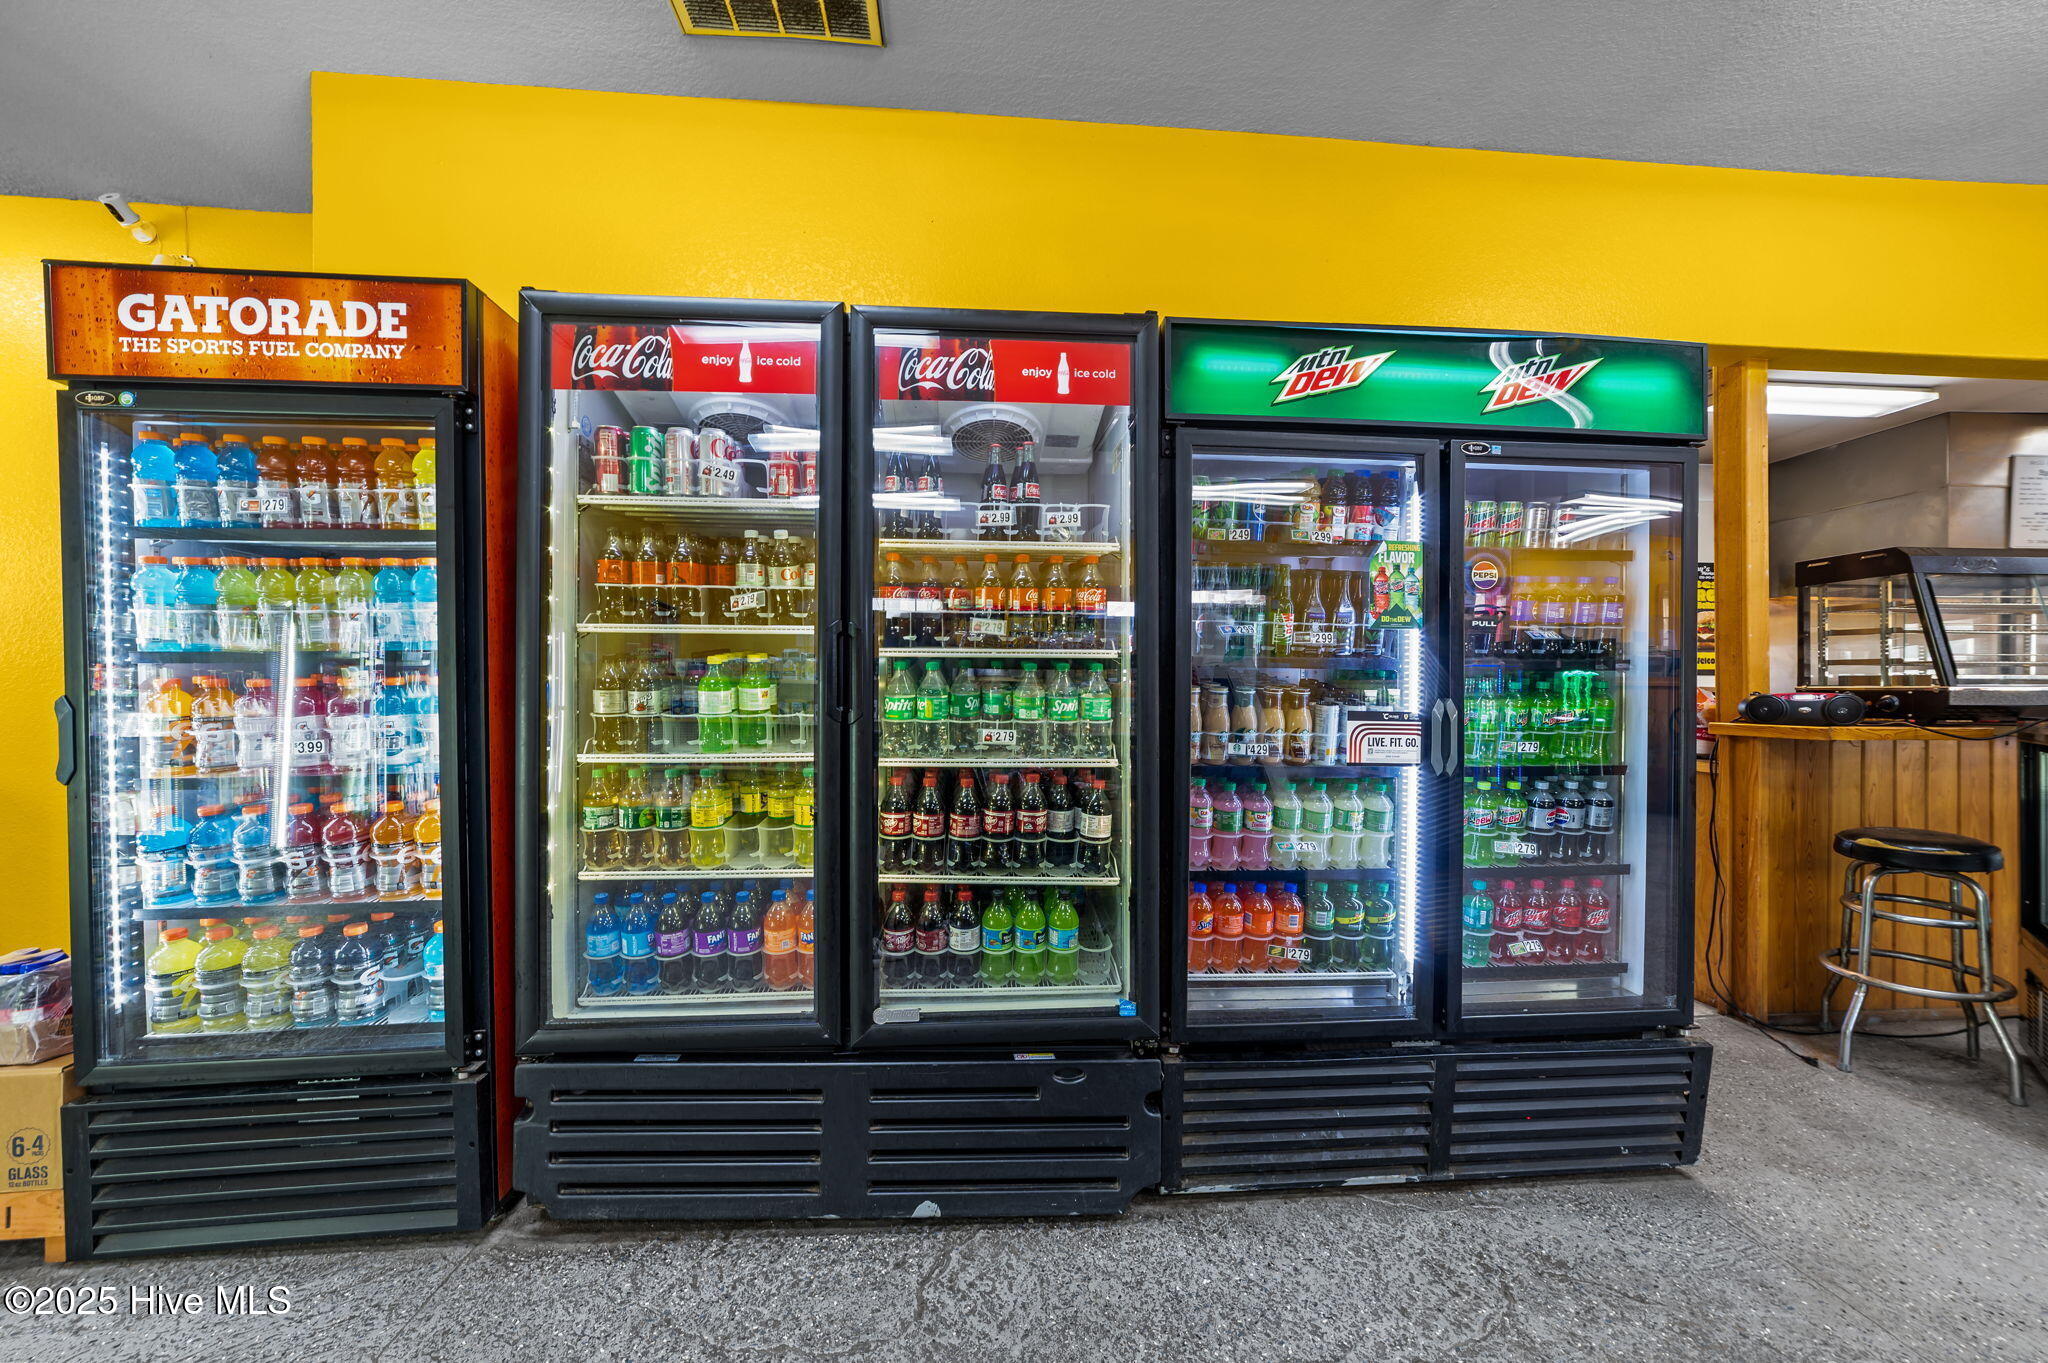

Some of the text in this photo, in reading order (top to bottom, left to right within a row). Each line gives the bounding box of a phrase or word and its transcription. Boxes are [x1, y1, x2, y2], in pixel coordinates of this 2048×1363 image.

[118, 293, 408, 339] GATORADE
[119, 336, 406, 359] THE SPORTS FUEL COMPANY
[571, 334, 674, 381] Coca-Cola
[701, 354, 734, 367] enjoy
[756, 355, 774, 366] ice
[776, 356, 801, 367] cold
[898, 347, 996, 392] Coca-Cola
[1021, 366, 1053, 379] enjoy
[1073, 367, 1090, 378] ice
[1092, 368, 1116, 379] cold
[1388, 544, 1421, 552] REFRESHING
[1378, 551, 1415, 564] FLAVOR
[1473, 571, 1497, 579] PEPSI
[1367, 737, 1419, 748] LIVE. FIT. GO.
[8, 1166, 49, 1181] GLASS
